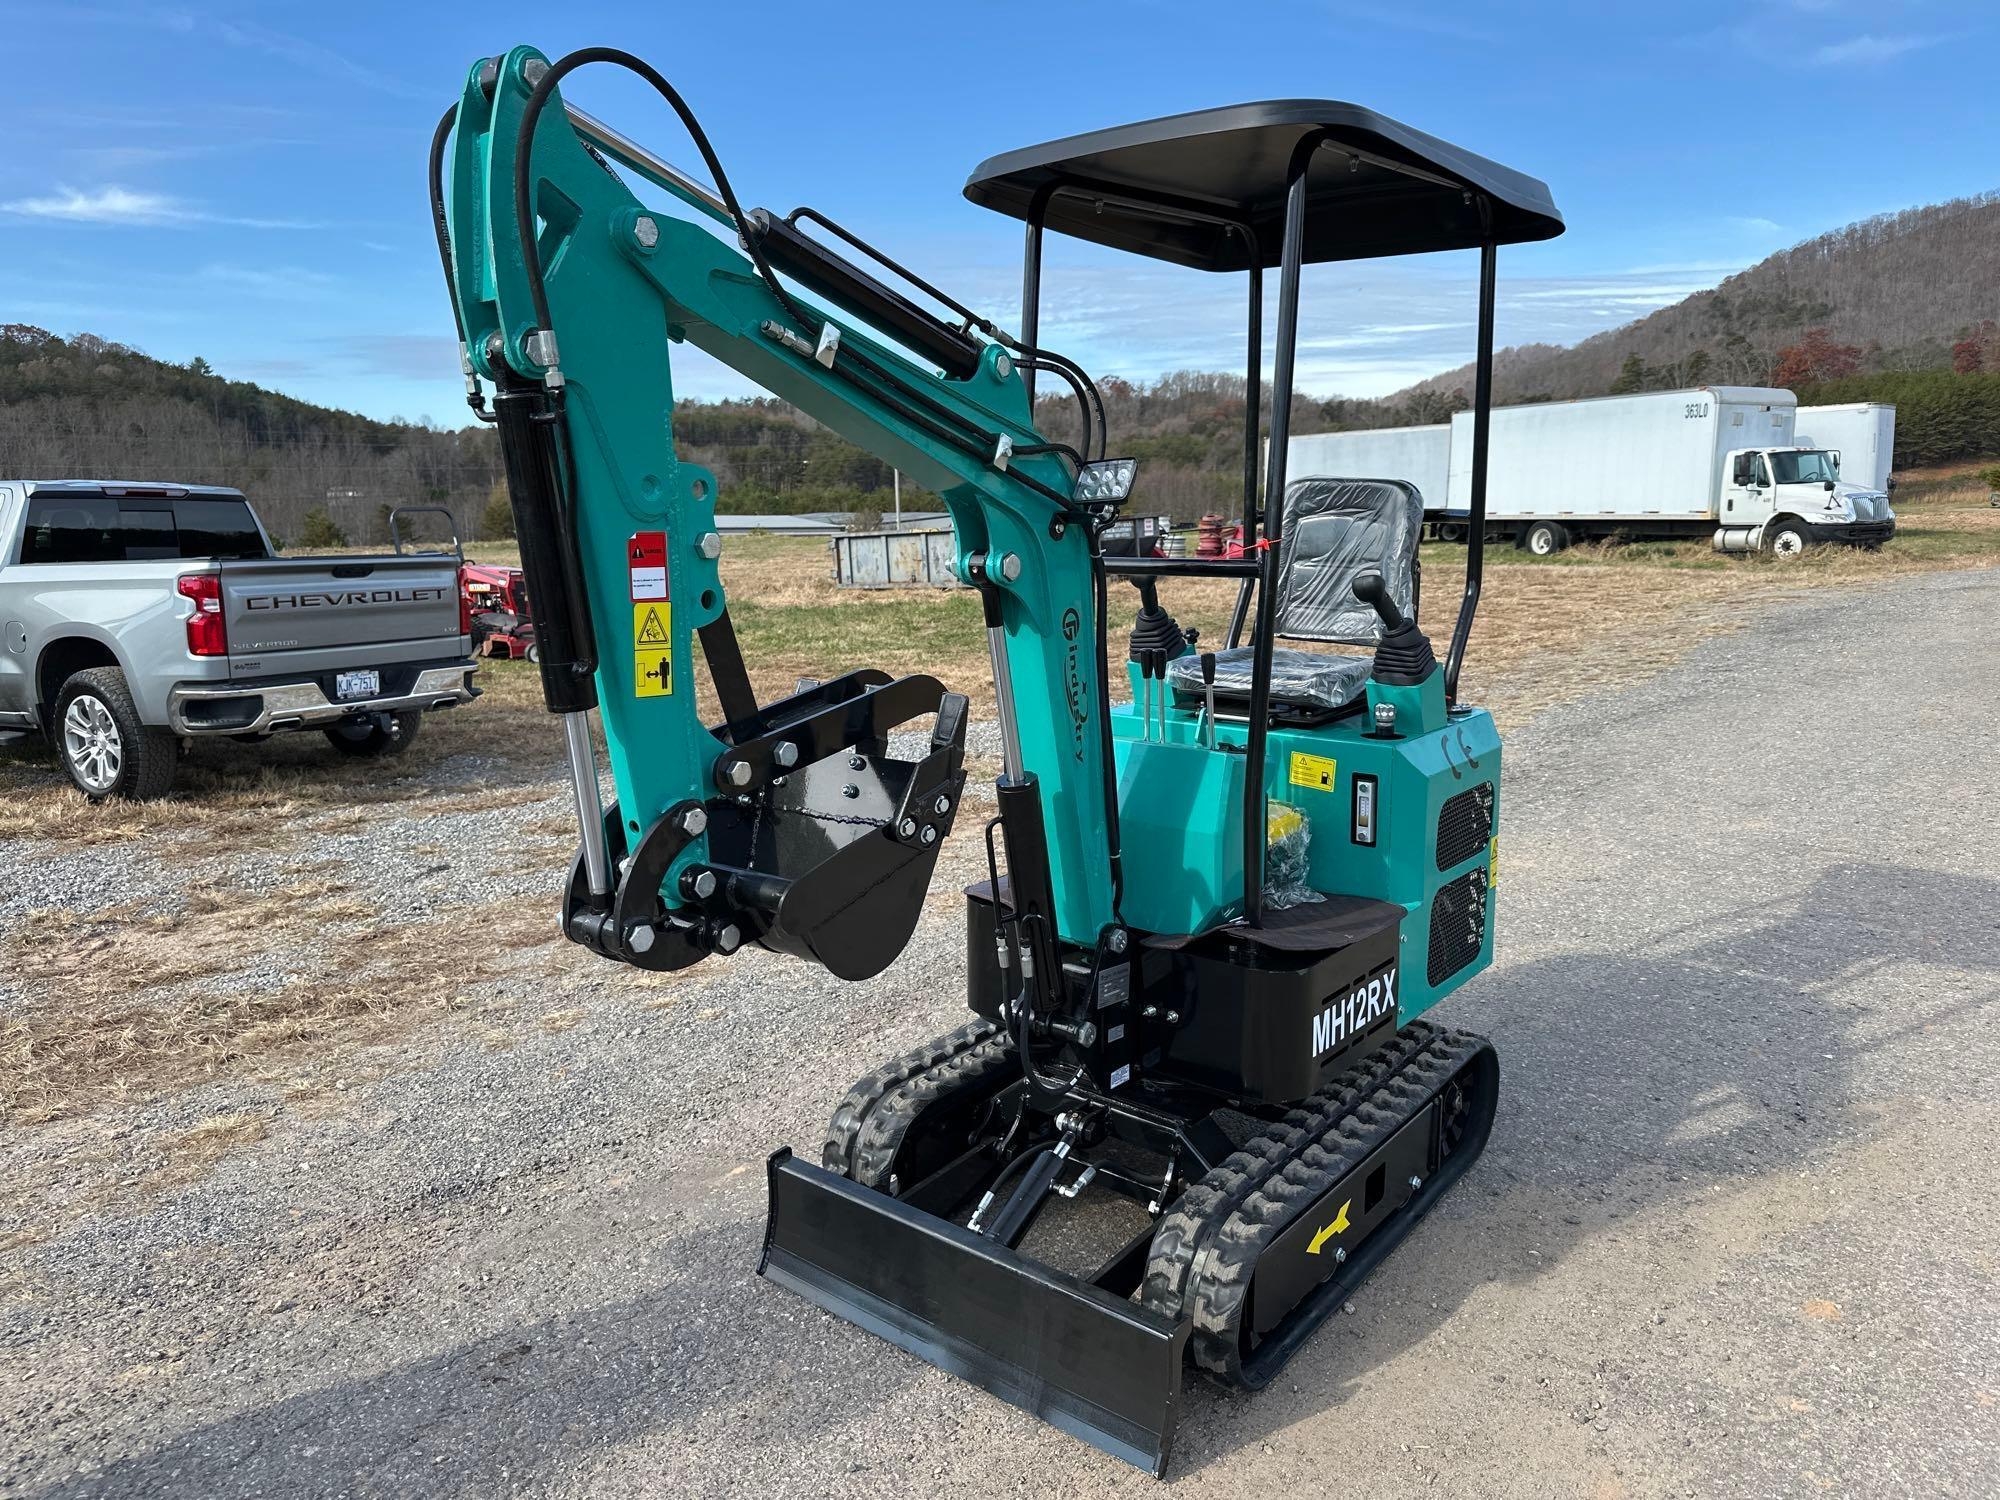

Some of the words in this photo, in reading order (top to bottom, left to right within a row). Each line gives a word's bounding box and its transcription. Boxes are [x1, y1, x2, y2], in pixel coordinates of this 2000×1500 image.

[247, 589, 447, 610] CHEVROLET
[233, 640, 298, 649] SILVERADO
[337, 676, 378, 692] KJK-7517
[1312, 968, 1396, 1057] MH12RX
